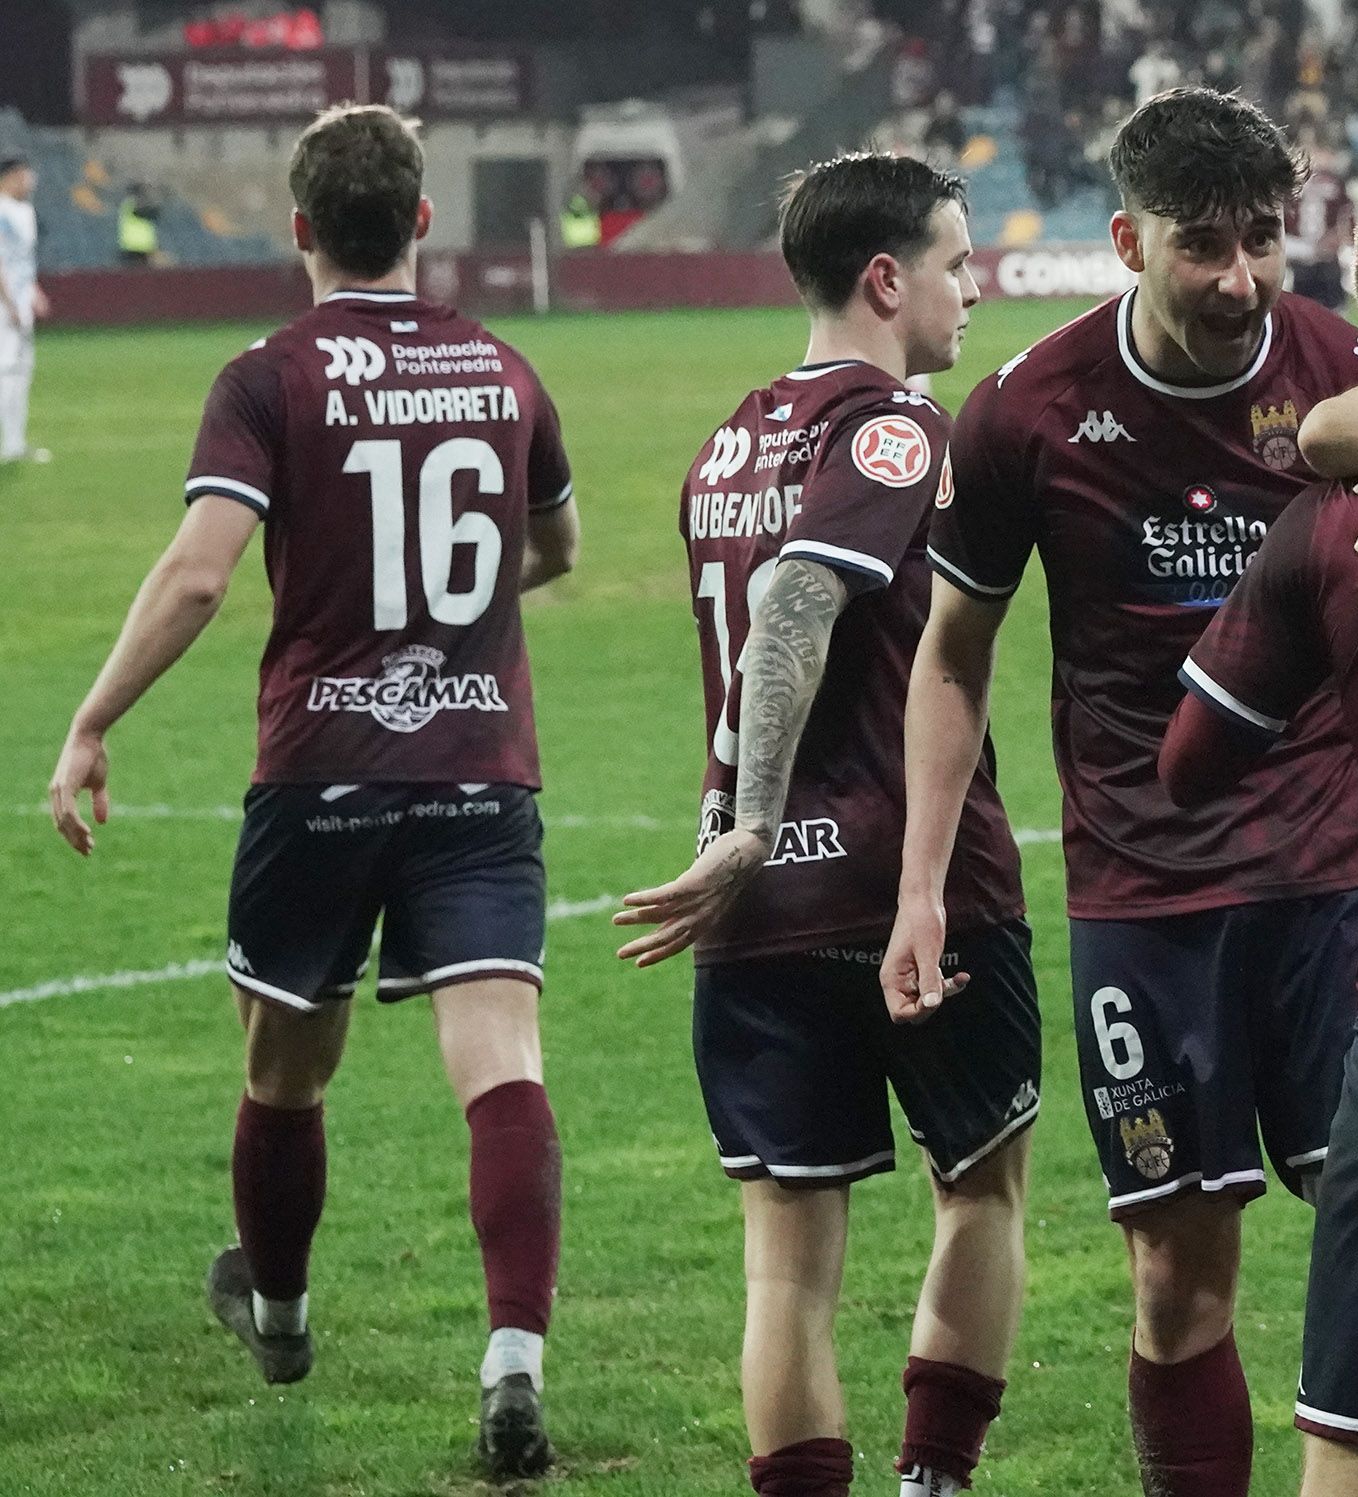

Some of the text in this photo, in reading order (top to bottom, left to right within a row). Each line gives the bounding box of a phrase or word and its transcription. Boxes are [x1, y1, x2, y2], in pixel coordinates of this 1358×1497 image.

[391, 341, 498, 360] Deputación
[396, 356, 502, 374] Pontevedra
[325, 385, 519, 426] A. VIDORRETA
[342, 437, 504, 631] 16
[1142, 515, 1267, 547] Estrella
[1090, 986, 1144, 1080] 6
[1111, 1078, 1154, 1099] XUNTA
[1114, 1082, 1186, 1113] DE GALICIA
